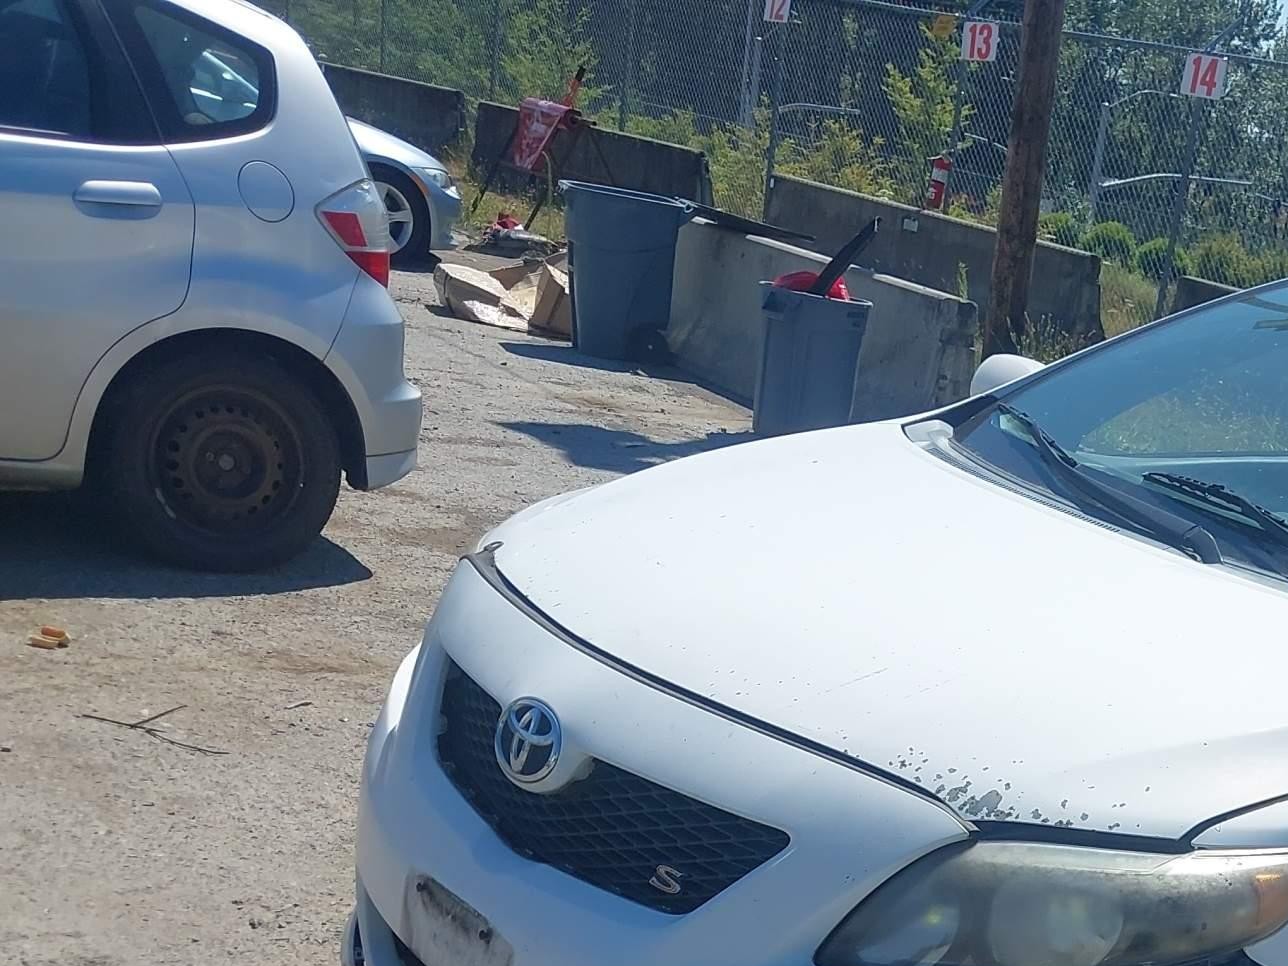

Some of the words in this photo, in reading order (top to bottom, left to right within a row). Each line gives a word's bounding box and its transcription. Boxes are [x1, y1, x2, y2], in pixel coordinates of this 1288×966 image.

[969, 23, 993, 60] 13
[1190, 55, 1219, 97] 14
[648, 864, 683, 894] S
